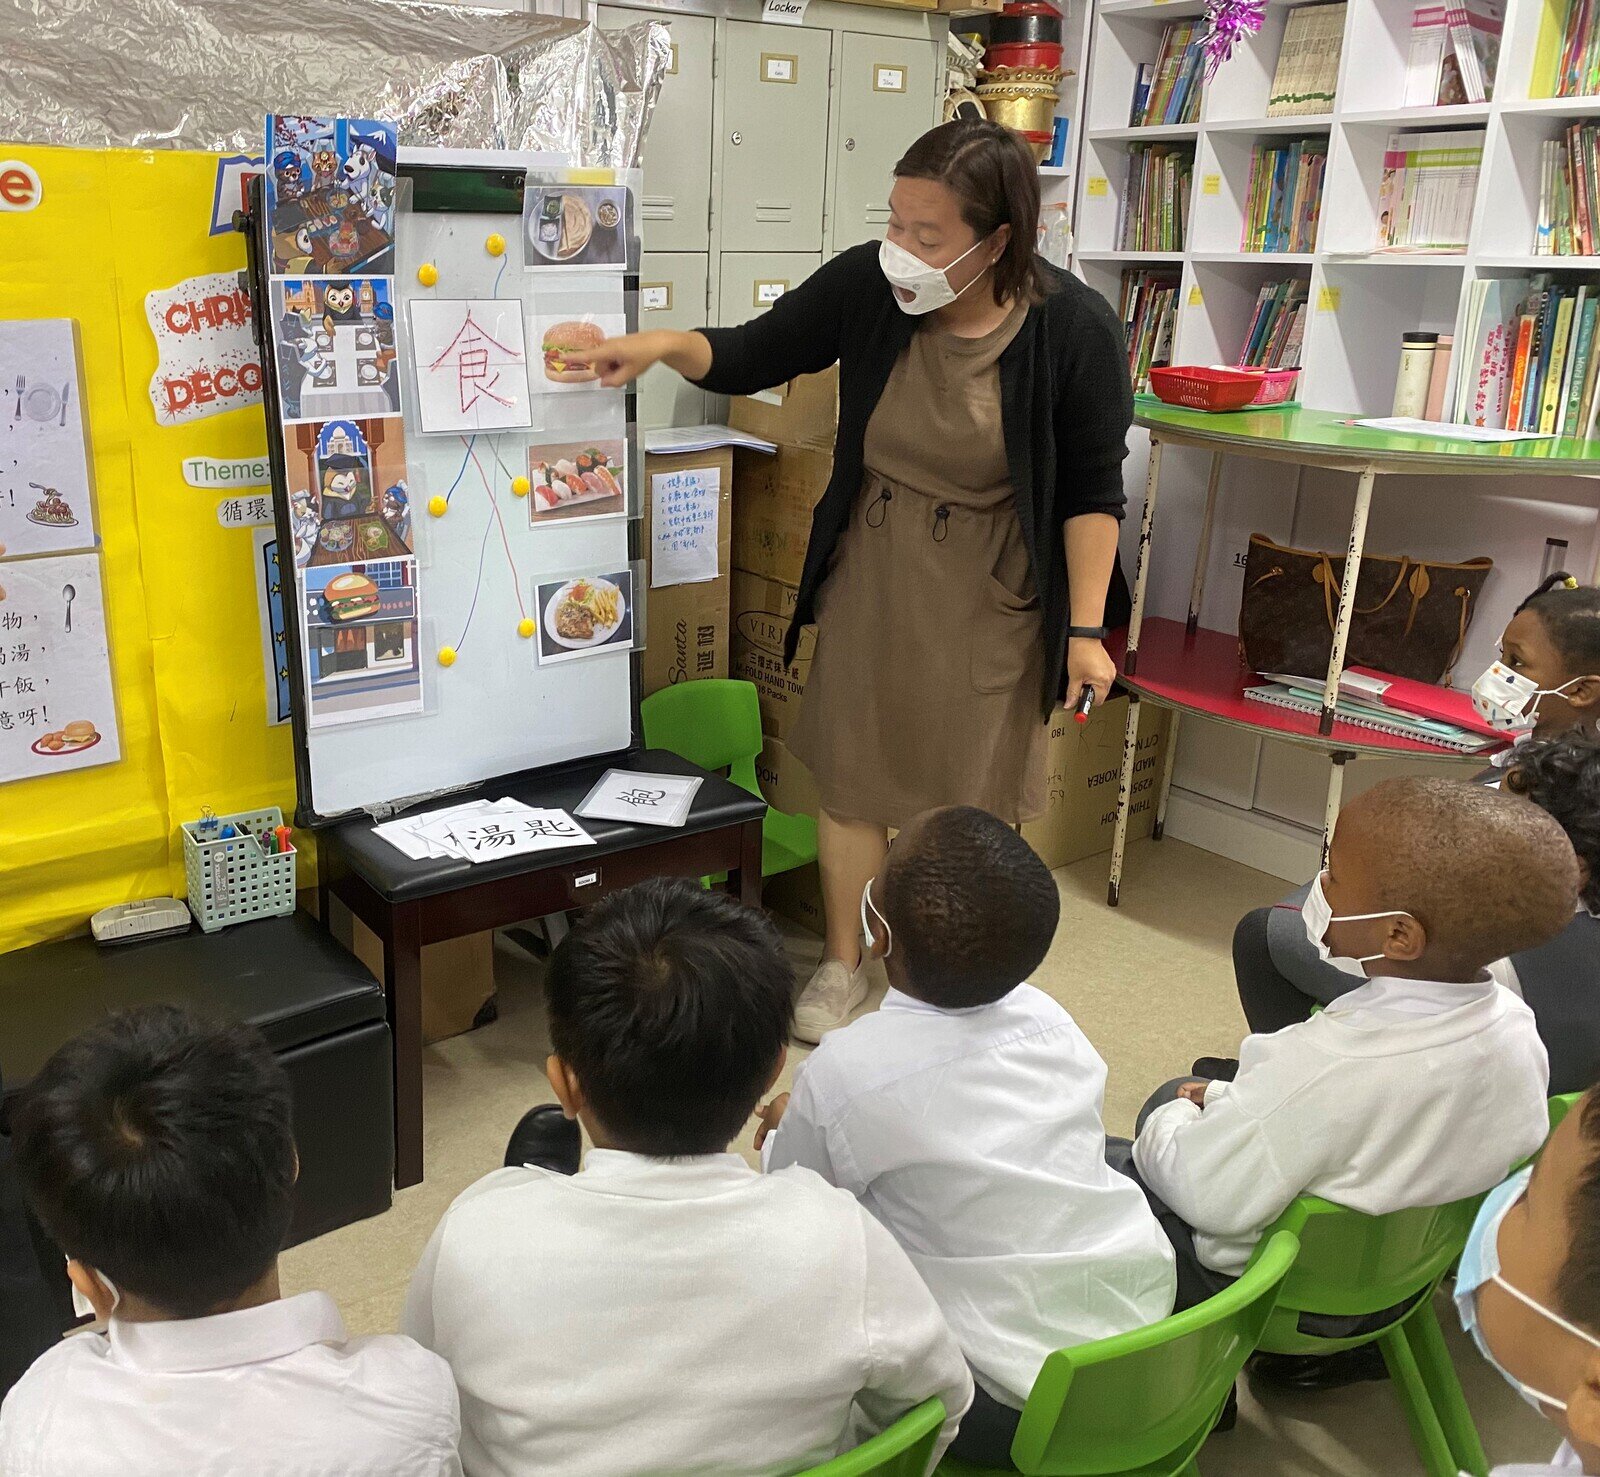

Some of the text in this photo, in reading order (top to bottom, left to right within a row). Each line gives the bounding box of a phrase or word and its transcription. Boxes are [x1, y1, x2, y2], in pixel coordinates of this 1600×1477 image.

[768, 0, 802, 14] Locker
[429, 309, 521, 413] 食
[163, 362, 262, 412] DECO
[189, 462, 270, 481] Theme:
[223, 498, 274, 522] 循環
[668, 618, 688, 684] Santa
[764, 672, 785, 689] HAND
[767, 687, 788, 703] Packs
[1088, 768, 1118, 788] KOREA
[1130, 778, 1154, 795] #295
[1128, 799, 1151, 816] THIN
[467, 820, 582, 850] 湯匙
